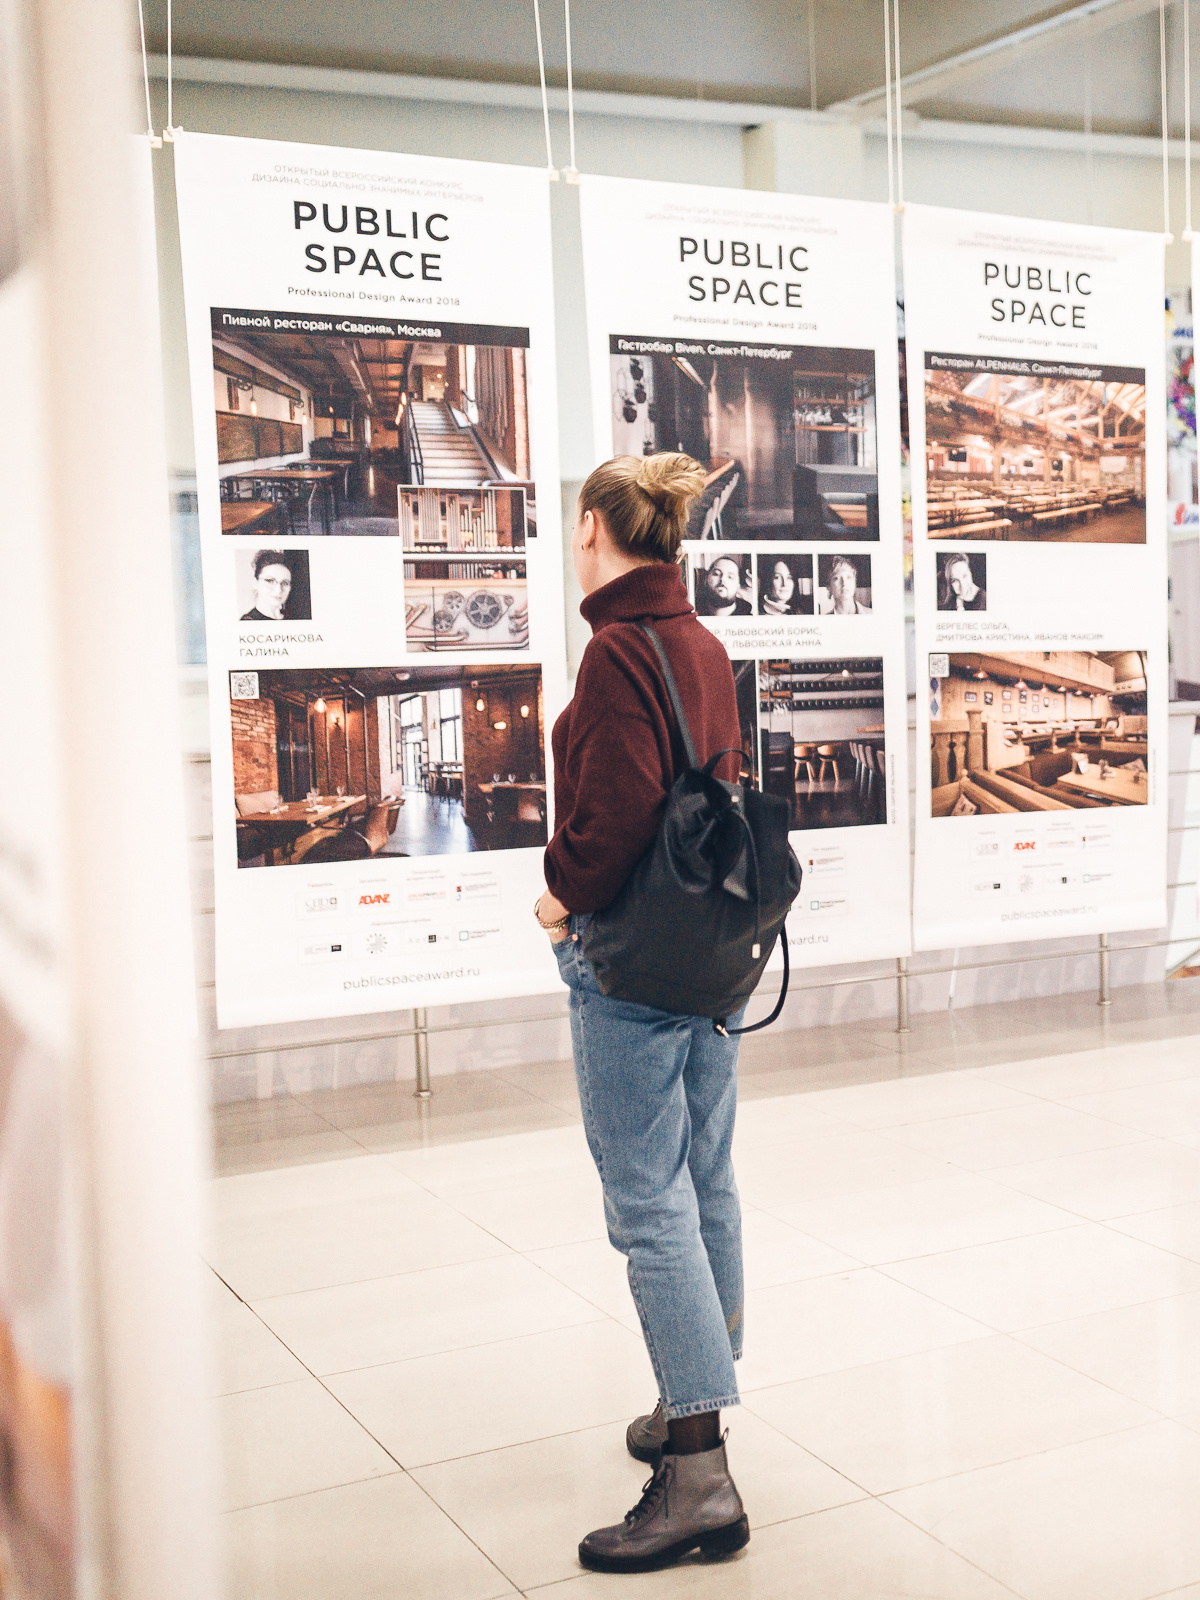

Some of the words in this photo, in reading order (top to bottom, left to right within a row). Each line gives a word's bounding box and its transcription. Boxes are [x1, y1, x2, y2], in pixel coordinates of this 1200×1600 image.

[252, 173, 300, 185] ДИЗАЙНА
[303, 178, 366, 191] СОЦИАЛЬНО
[369, 184, 420, 196] ЗНАЧИМЫХ
[424, 189, 483, 202] ИНТЕРЬЕРОВ
[274, 165, 329, 177] ОТКРЫТЫЙ
[332, 171, 417, 185] ВСЕРОССИЙСКИЙ
[420, 180, 463, 190] КОНКУРС
[293, 200, 450, 241] PUBLIC
[305, 243, 443, 281] SPACE
[679, 236, 810, 272] PUBLIC
[984, 262, 1092, 296] PUBLIC
[288, 287, 354, 299] Professional
[359, 291, 395, 302] Design
[400, 294, 432, 305] Award
[436, 296, 460, 306] 2018
[688, 275, 803, 309] SPACE
[222, 313, 271, 327] Пивной
[274, 318, 332, 331] ресторан
[336, 321, 394, 336] «Сварня»,
[398, 325, 441, 338] Москва
[673, 314, 729, 326] Professional
[732, 317, 763, 328] Design
[767, 321, 794, 330] Award
[798, 322, 818, 331] 2018
[991, 298, 1086, 329] SPACE
[618, 340, 673, 353] Гастробар
[708, 344, 792, 360] Санкт-Петербург
[239, 633, 324, 644] КОСАРИКОВА
[725, 627, 784, 637] ЛЬВОВСКИЙ
[787, 627, 822, 636] БОРИС,
[732, 639, 792, 649] ЛЬВОВСКАЯ
[795, 639, 821, 647] АННА
[239, 647, 289, 657] ГАЛИНА
[1001, 905, 1098, 922] publicspaceaward.ru
[343, 967, 480, 991] publicspaceaward.ru
